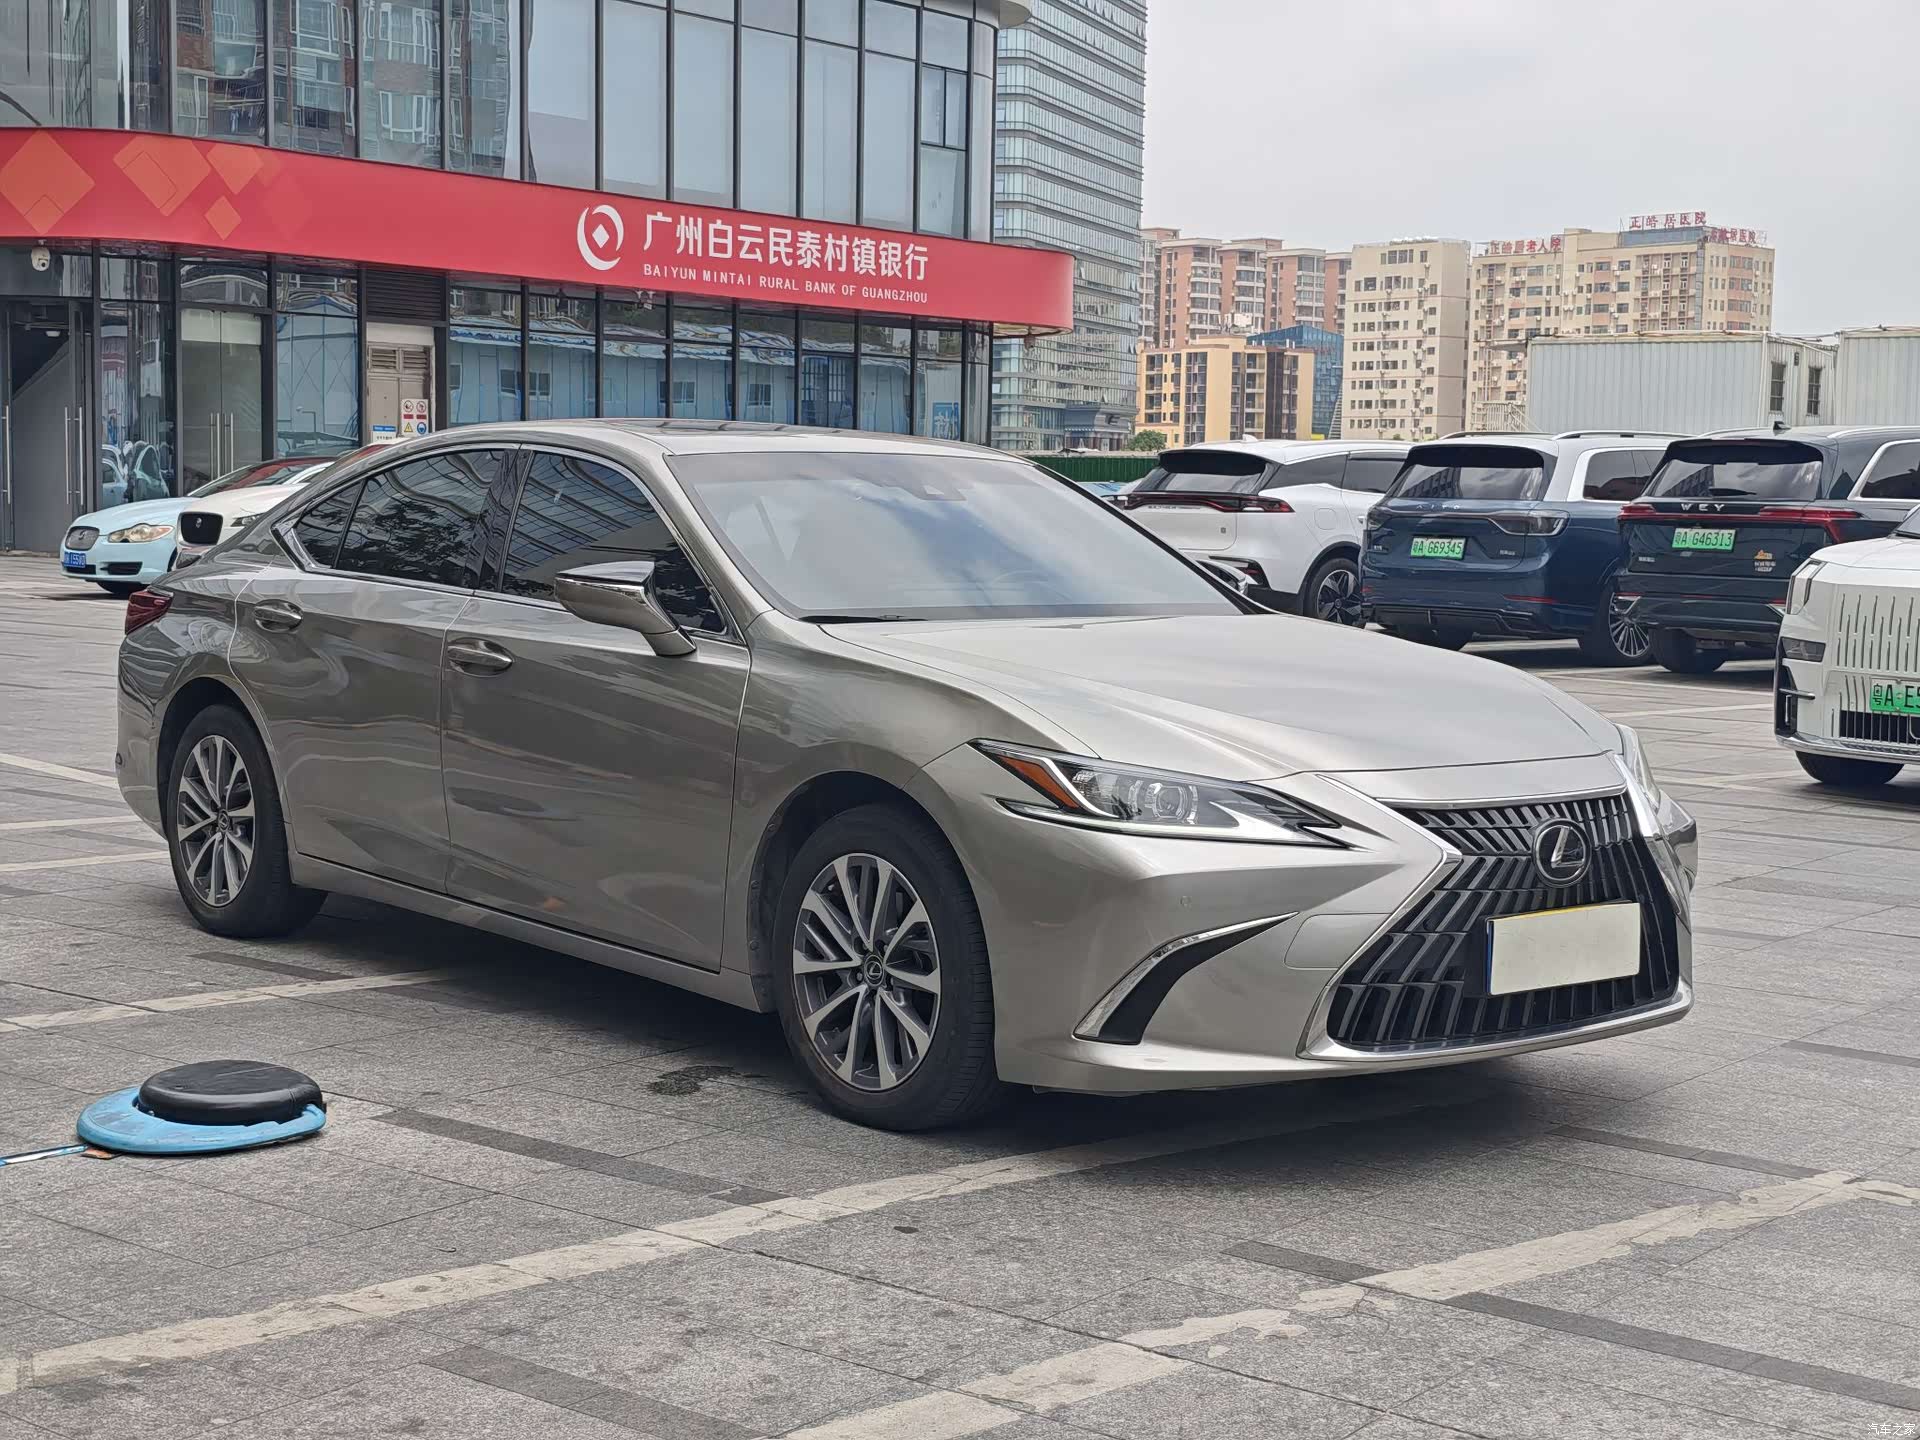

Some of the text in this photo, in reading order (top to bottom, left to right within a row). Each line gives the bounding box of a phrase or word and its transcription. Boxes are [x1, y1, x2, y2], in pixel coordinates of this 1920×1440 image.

[643, 211, 929, 281] 广州白云民泰村镇银行
[643, 263, 928, 304] BAIYUN MINTAI RURAL BANK OF GUANGZHOU
[1681, 503, 1725, 512] WEY
[1427, 541, 1464, 555] G69345
[1692, 532, 1733, 548] G46313
